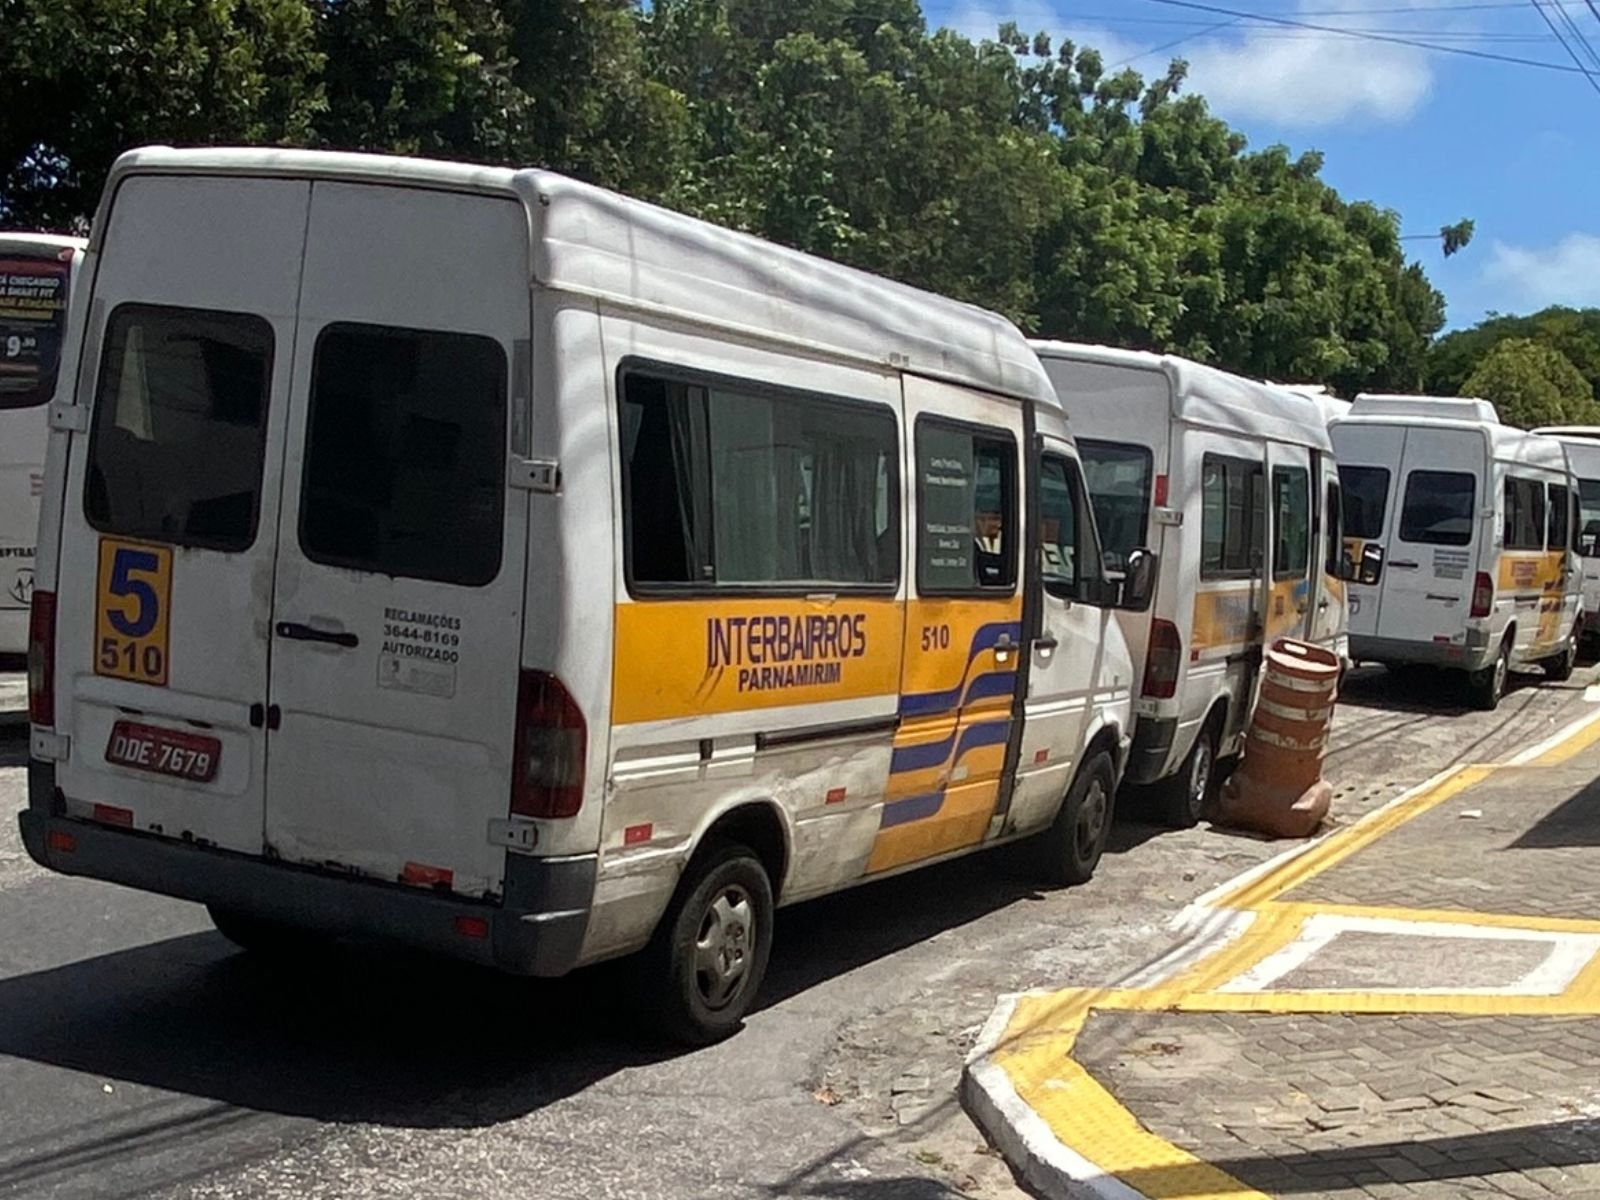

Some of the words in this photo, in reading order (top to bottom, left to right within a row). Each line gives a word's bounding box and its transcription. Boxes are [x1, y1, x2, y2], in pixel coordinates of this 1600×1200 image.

[106, 548, 158, 638] 5
[383, 623, 460, 647] 3644-8169
[707, 614, 866, 668] INTERBAIRROS
[921, 625, 949, 651] 510
[100, 637, 162, 678] 510
[382, 640, 459, 664] AUTORIZADO
[738, 662, 841, 693] PARNAMIRIM
